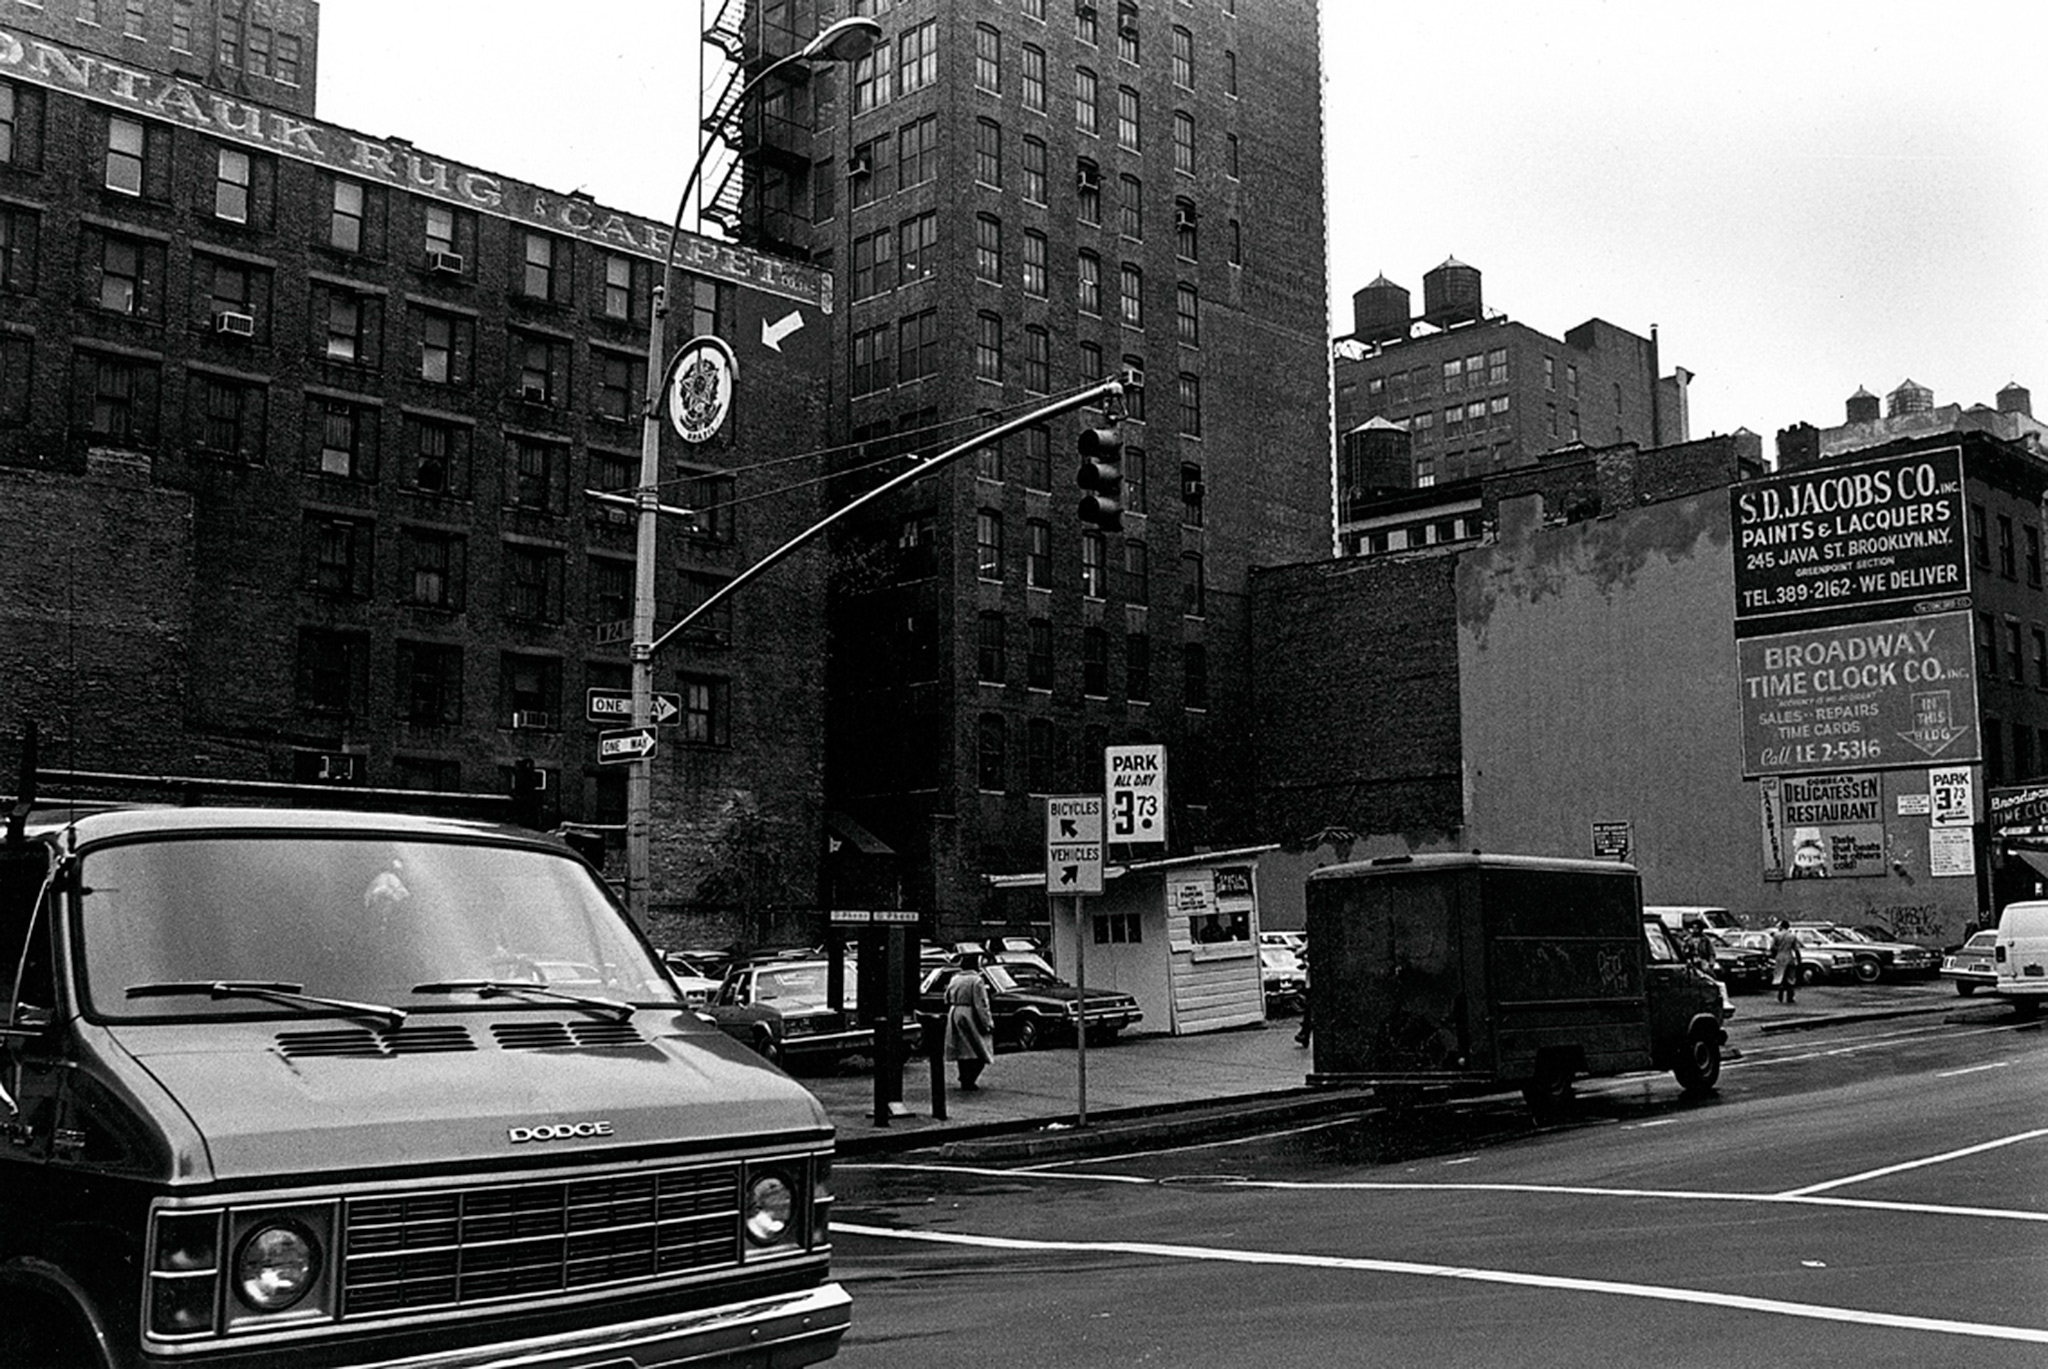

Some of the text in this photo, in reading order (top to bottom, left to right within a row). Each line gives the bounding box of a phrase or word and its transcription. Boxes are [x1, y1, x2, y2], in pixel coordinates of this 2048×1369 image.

[350, 137, 501, 206] RUG
[560, 198, 783, 284] CARPET
[1897, 463, 1940, 500] CO.
[1742, 500, 1951, 548] PAINTS & LACQUERS
[1746, 551, 1775, 570] 245
[1779, 546, 1819, 566] JAVA
[1824, 543, 1845, 559] ST.
[1795, 556, 1895, 577] GREENPOINT SECTION
[1859, 573, 1886, 593] WE
[1890, 564, 1959, 589] DELIVER
[1764, 628, 1936, 670] BROADWAY
[1746, 657, 1970, 699] TIME CLOCK CO. INC.
[596, 699, 623, 713] ONE
[1759, 702, 1879, 725] SALES REPAIRS
[1922, 697, 1937, 710] IN
[1916, 710, 1946, 725] THIS
[1778, 721, 1860, 739] TIME CARDS
[604, 737, 649, 753] ONE WAY
[1113, 754, 1158, 772] PARK
[1760, 746, 1791, 767] Call
[1114, 773, 1157, 787] ALL DAY
[1784, 777, 1878, 802] DELICATESSEN
[1932, 772, 1969, 786] PARK
[1050, 802, 1099, 816] BICYCLES
[1787, 801, 1878, 823] RESTAURANT
[1992, 807, 2020, 825] TIME
[510, 1121, 614, 1141] DODGE
